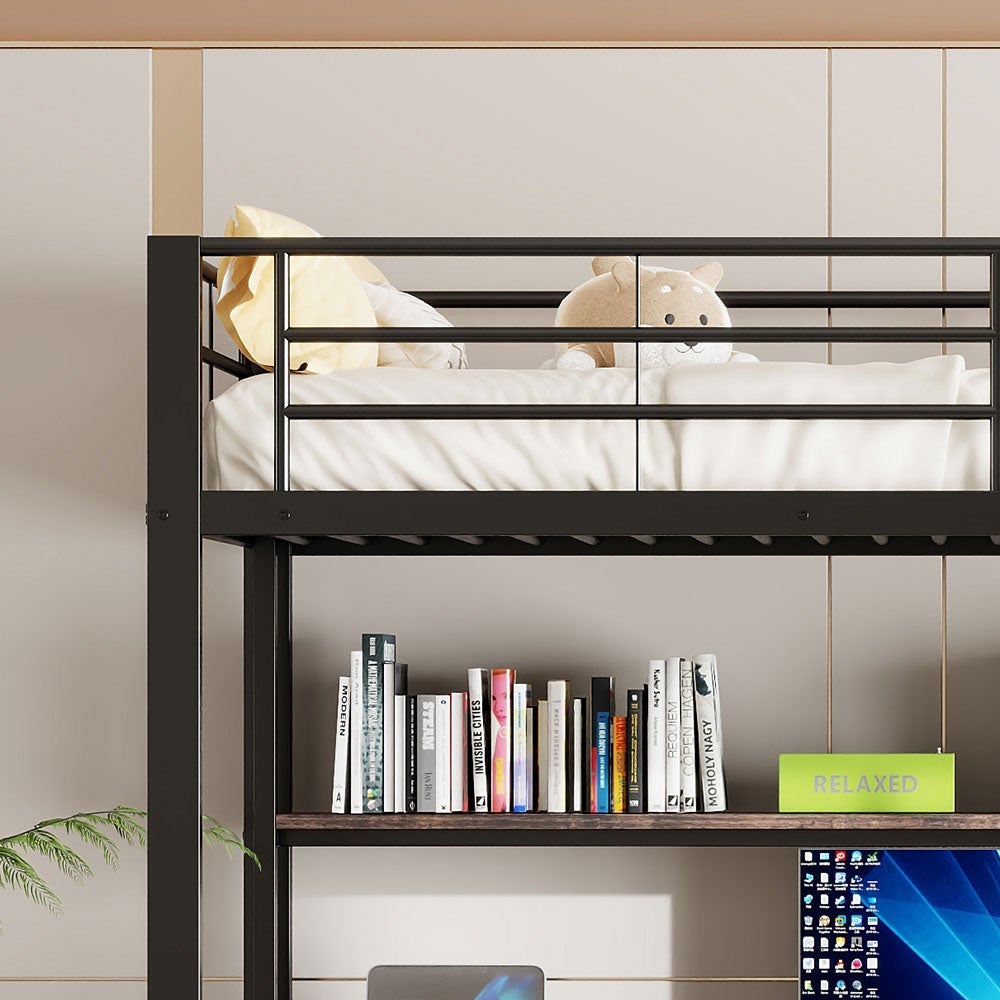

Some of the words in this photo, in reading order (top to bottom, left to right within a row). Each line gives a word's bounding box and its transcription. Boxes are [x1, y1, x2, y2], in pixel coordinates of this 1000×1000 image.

[339, 685, 348, 736] MODERN
[422, 701, 435, 750] STEAM
[472, 700, 480, 728] CITIES
[668, 702, 678, 758] REQUIEM
[474, 732, 484, 774] INVISIBLE
[702, 720, 714, 752] NAGY
[706, 757, 718, 806] MOHOLY
[814, 775, 918, 793] RELAXED
